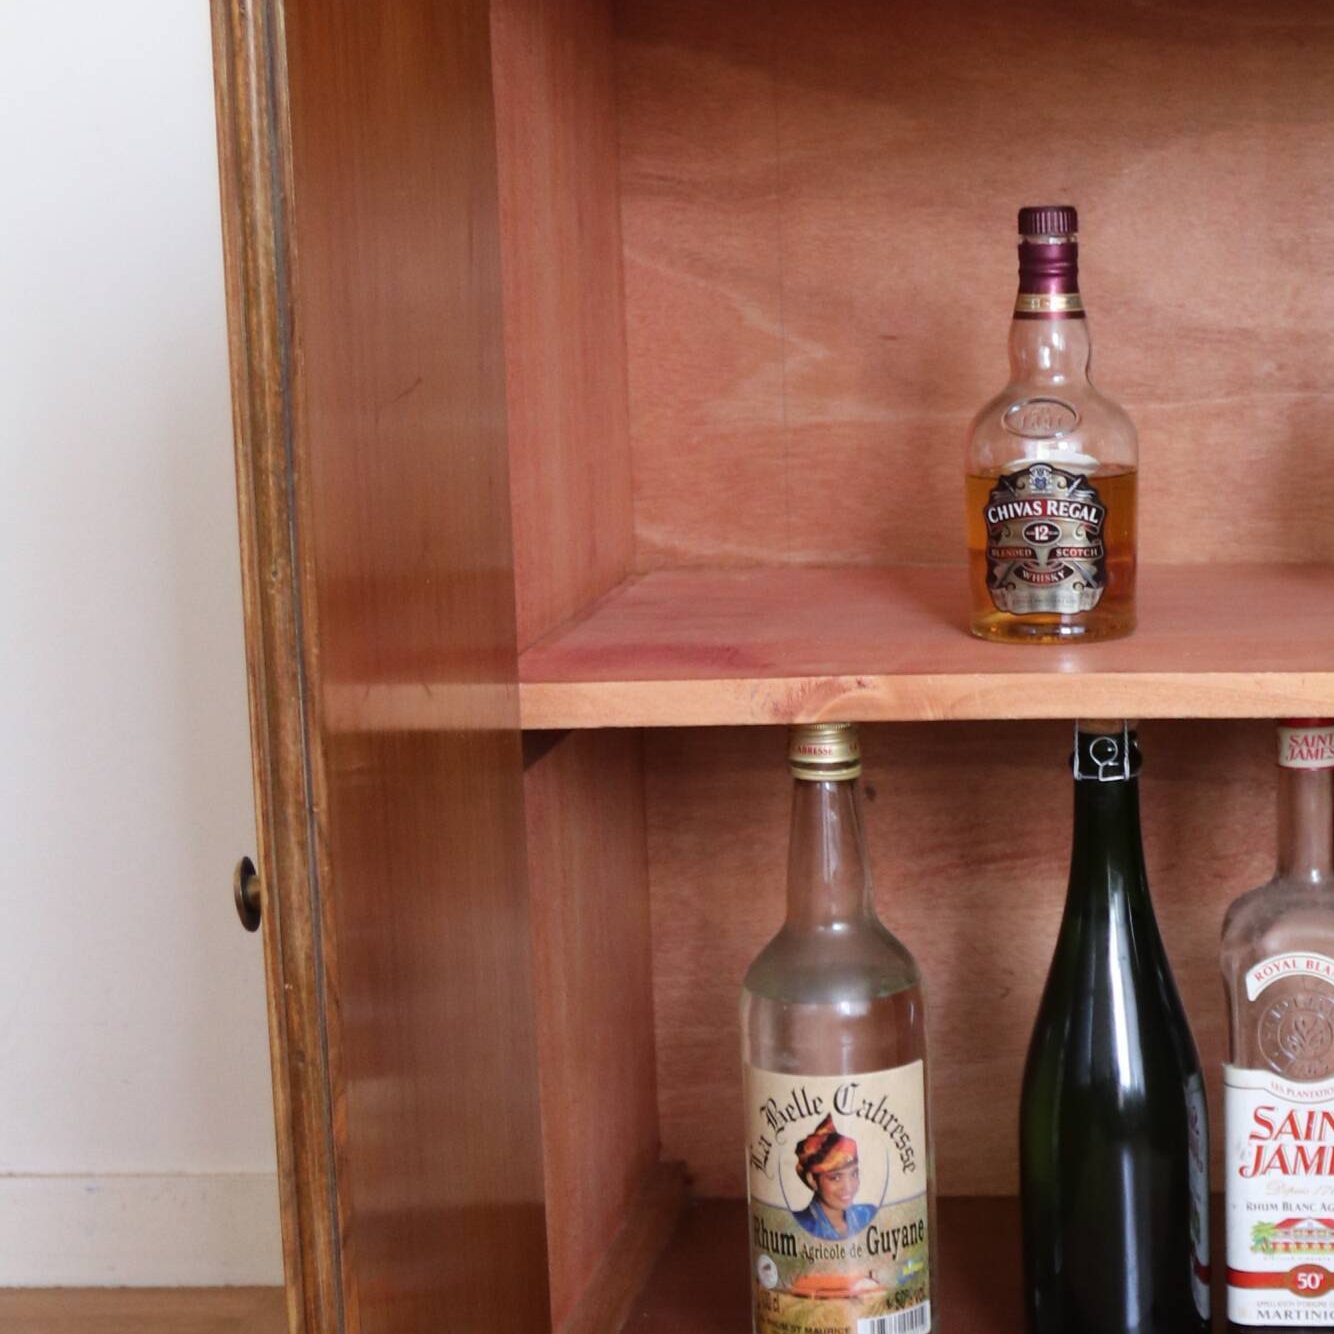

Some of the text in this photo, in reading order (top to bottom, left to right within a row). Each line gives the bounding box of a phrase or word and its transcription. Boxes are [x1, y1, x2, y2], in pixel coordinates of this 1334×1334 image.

[988, 500, 1099, 524] CHIVAS REGAL
[1033, 525, 1049, 541] 12
[991, 546, 1032, 557] BLENDED
[1055, 547, 1098, 557] SCOTCH
[1022, 569, 1066, 584] WHISKY
[1289, 732, 1334, 748] SAINT
[1253, 959, 1298, 982] ROYAL
[750, 1082, 917, 1178] La Belle Cabresse
[1246, 1202, 1279, 1213] RHUM
[1282, 1202, 1315, 1213] BLANC
[752, 1217, 925, 1264] Rhum Agricole de Guyane
